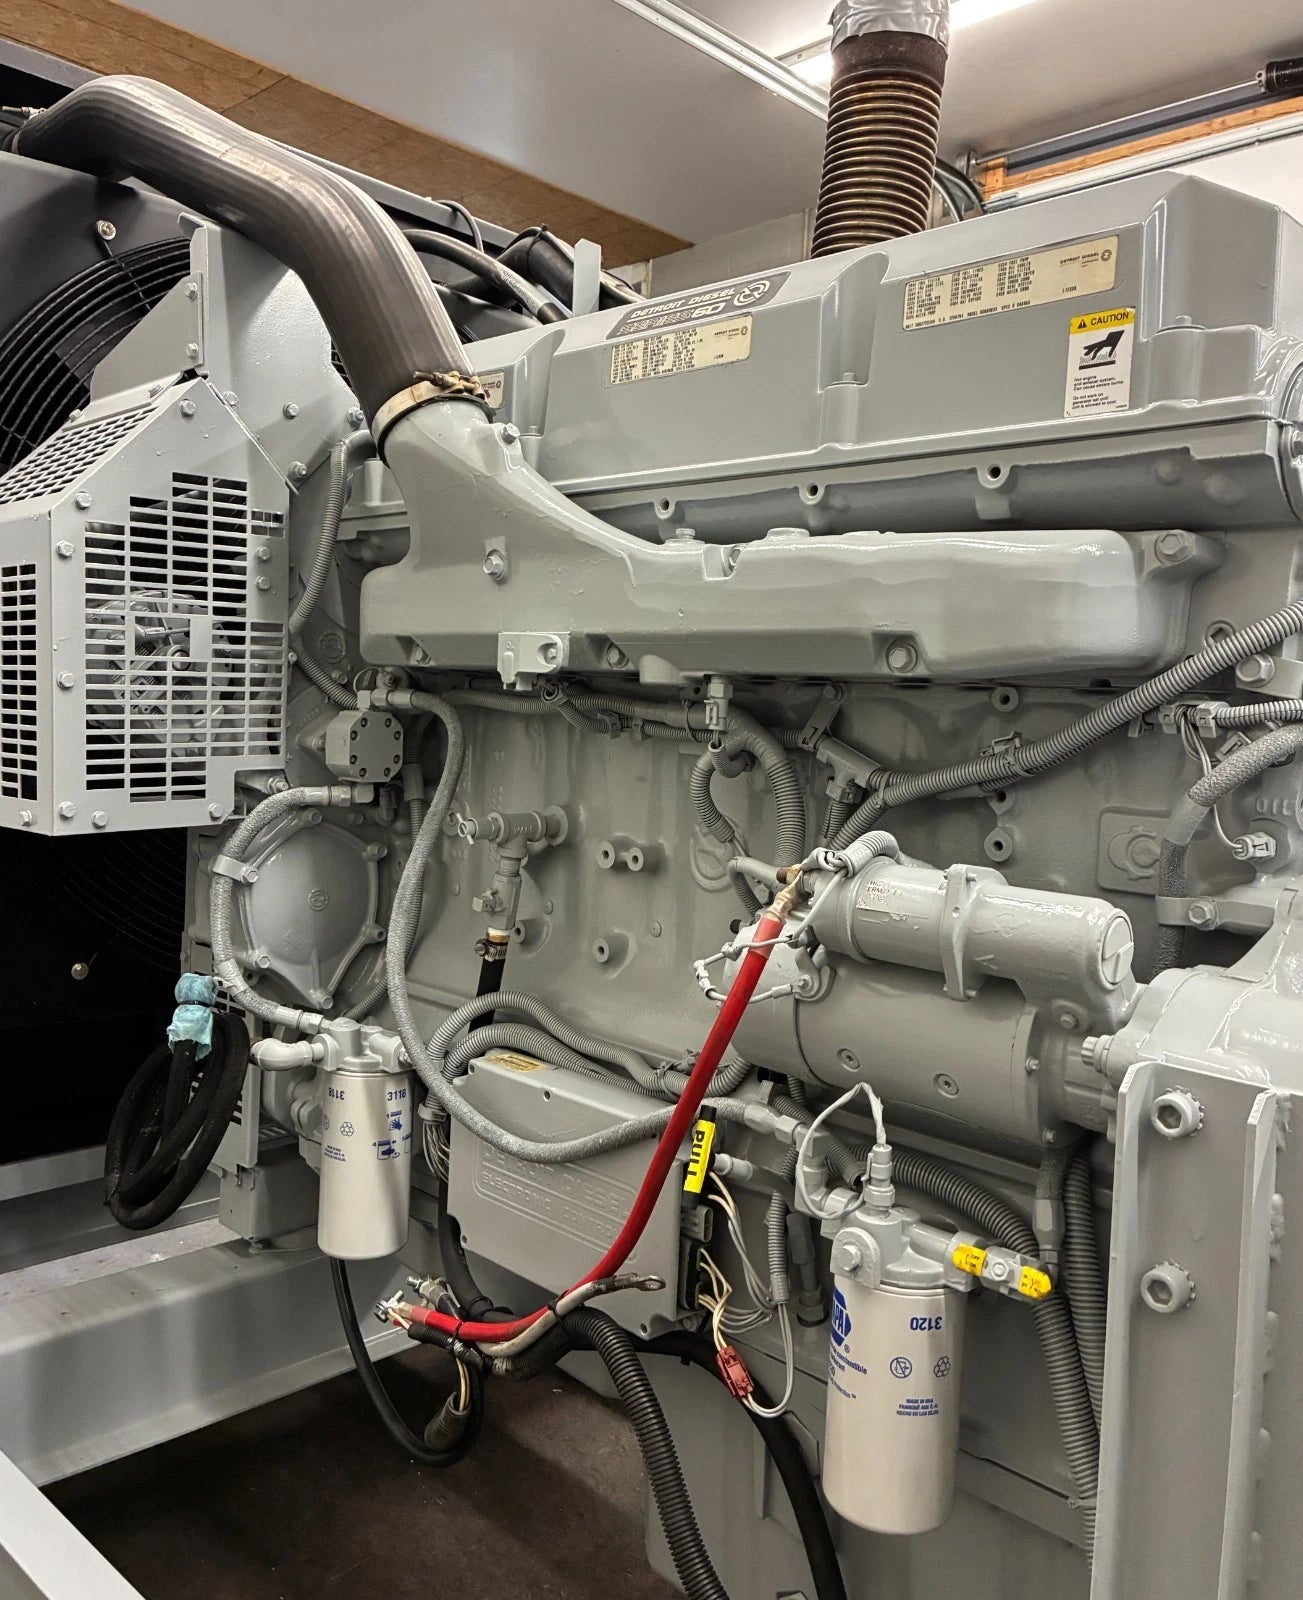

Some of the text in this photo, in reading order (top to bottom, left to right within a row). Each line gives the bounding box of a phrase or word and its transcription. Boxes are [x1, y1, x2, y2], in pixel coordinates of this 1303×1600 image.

[631, 288, 735, 318] DETROIT DIESEL
[692, 302, 726, 318] 60
[1090, 312, 1129, 326] CAUTION
[328, 1087, 345, 1100] 3118
[387, 1089, 406, 1101] 3118
[686, 1130, 705, 1181] PULL
[482, 1171, 551, 1210] ELECTRONIC
[910, 1316, 942, 1331] 3120
[837, 1351, 868, 1374] combustible
